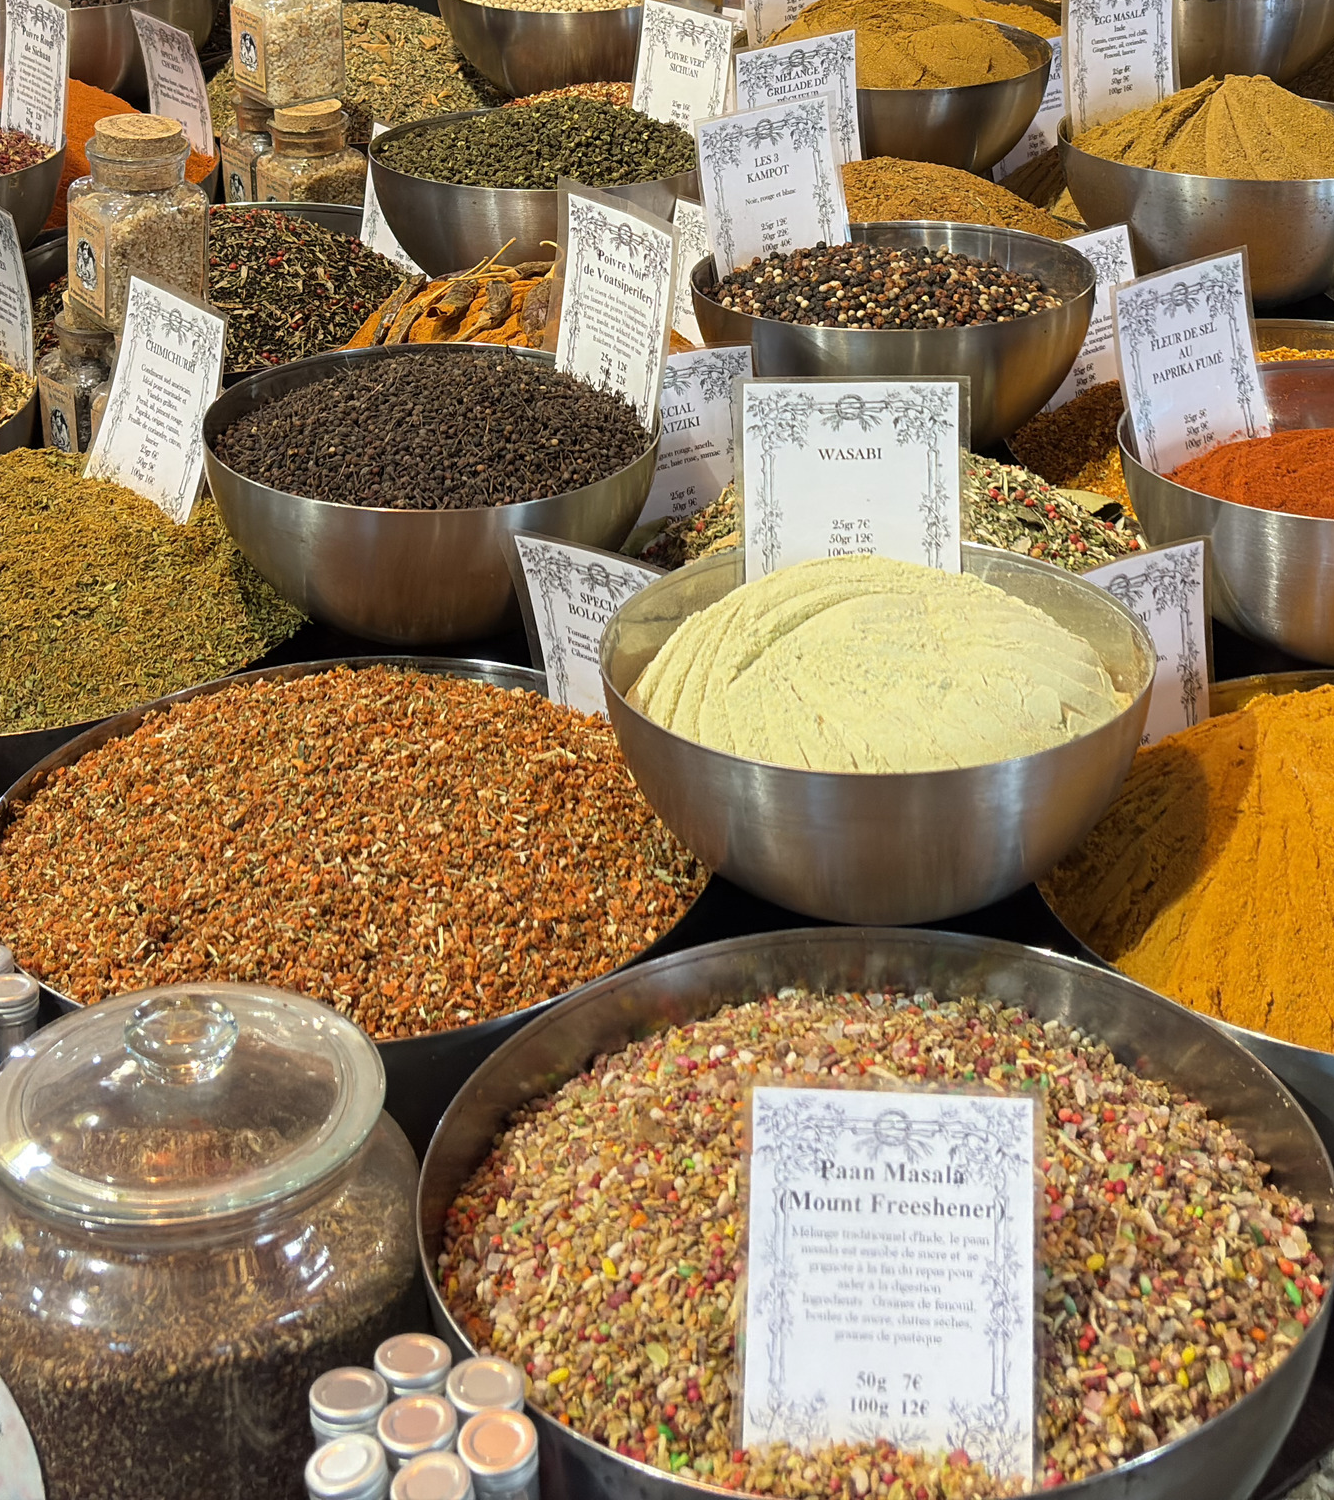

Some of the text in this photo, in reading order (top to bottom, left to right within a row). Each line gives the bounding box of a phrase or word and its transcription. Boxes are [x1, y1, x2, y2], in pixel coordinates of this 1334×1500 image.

[1094, 8, 1146, 26] EGG MASALA
[669, 62, 699, 79] SICHUAN
[767, 75, 828, 98] GRILLADE DU
[755, 155, 772, 168] LES
[747, 164, 790, 183] KAMPOT
[745, 198, 760, 206] Noir,
[760, 193, 774, 203] rouge
[761, 221, 774, 231] 25gr
[762, 233, 776, 241] 50gr
[762, 243, 779, 253] 100gr
[598, 249, 627, 272] Poivre
[584, 263, 654, 308] de Voatsiperifery
[1150, 321, 1217, 351] FLEUR DE SEL
[146, 339, 196, 374] CHIMICHURRI
[601, 352, 613, 366] 25g
[1178, 345, 1193, 360] AU
[1152, 363, 1195, 384] PAPRIKA
[661, 403, 696, 419] ÉCIAL
[661, 416, 700, 434] ATZIKI
[818, 448, 881, 460] WASABI
[832, 519, 870, 531] 25gr 7€
[829, 533, 873, 545] 50gr 12€
[580, 592, 618, 612] SPECIA
[821, 1160, 964, 1185] Paan Masala
[780, 1191, 861, 1213] (Mount
[867, 1263, 877, 1274] la
[898, 1265, 912, 1276] du
[916, 1268, 944, 1279] repas
[948, 1269, 973, 1280] pour
[856, 1373, 922, 1392] 50g 7€
[850, 1397, 930, 1417] 100g 12€
